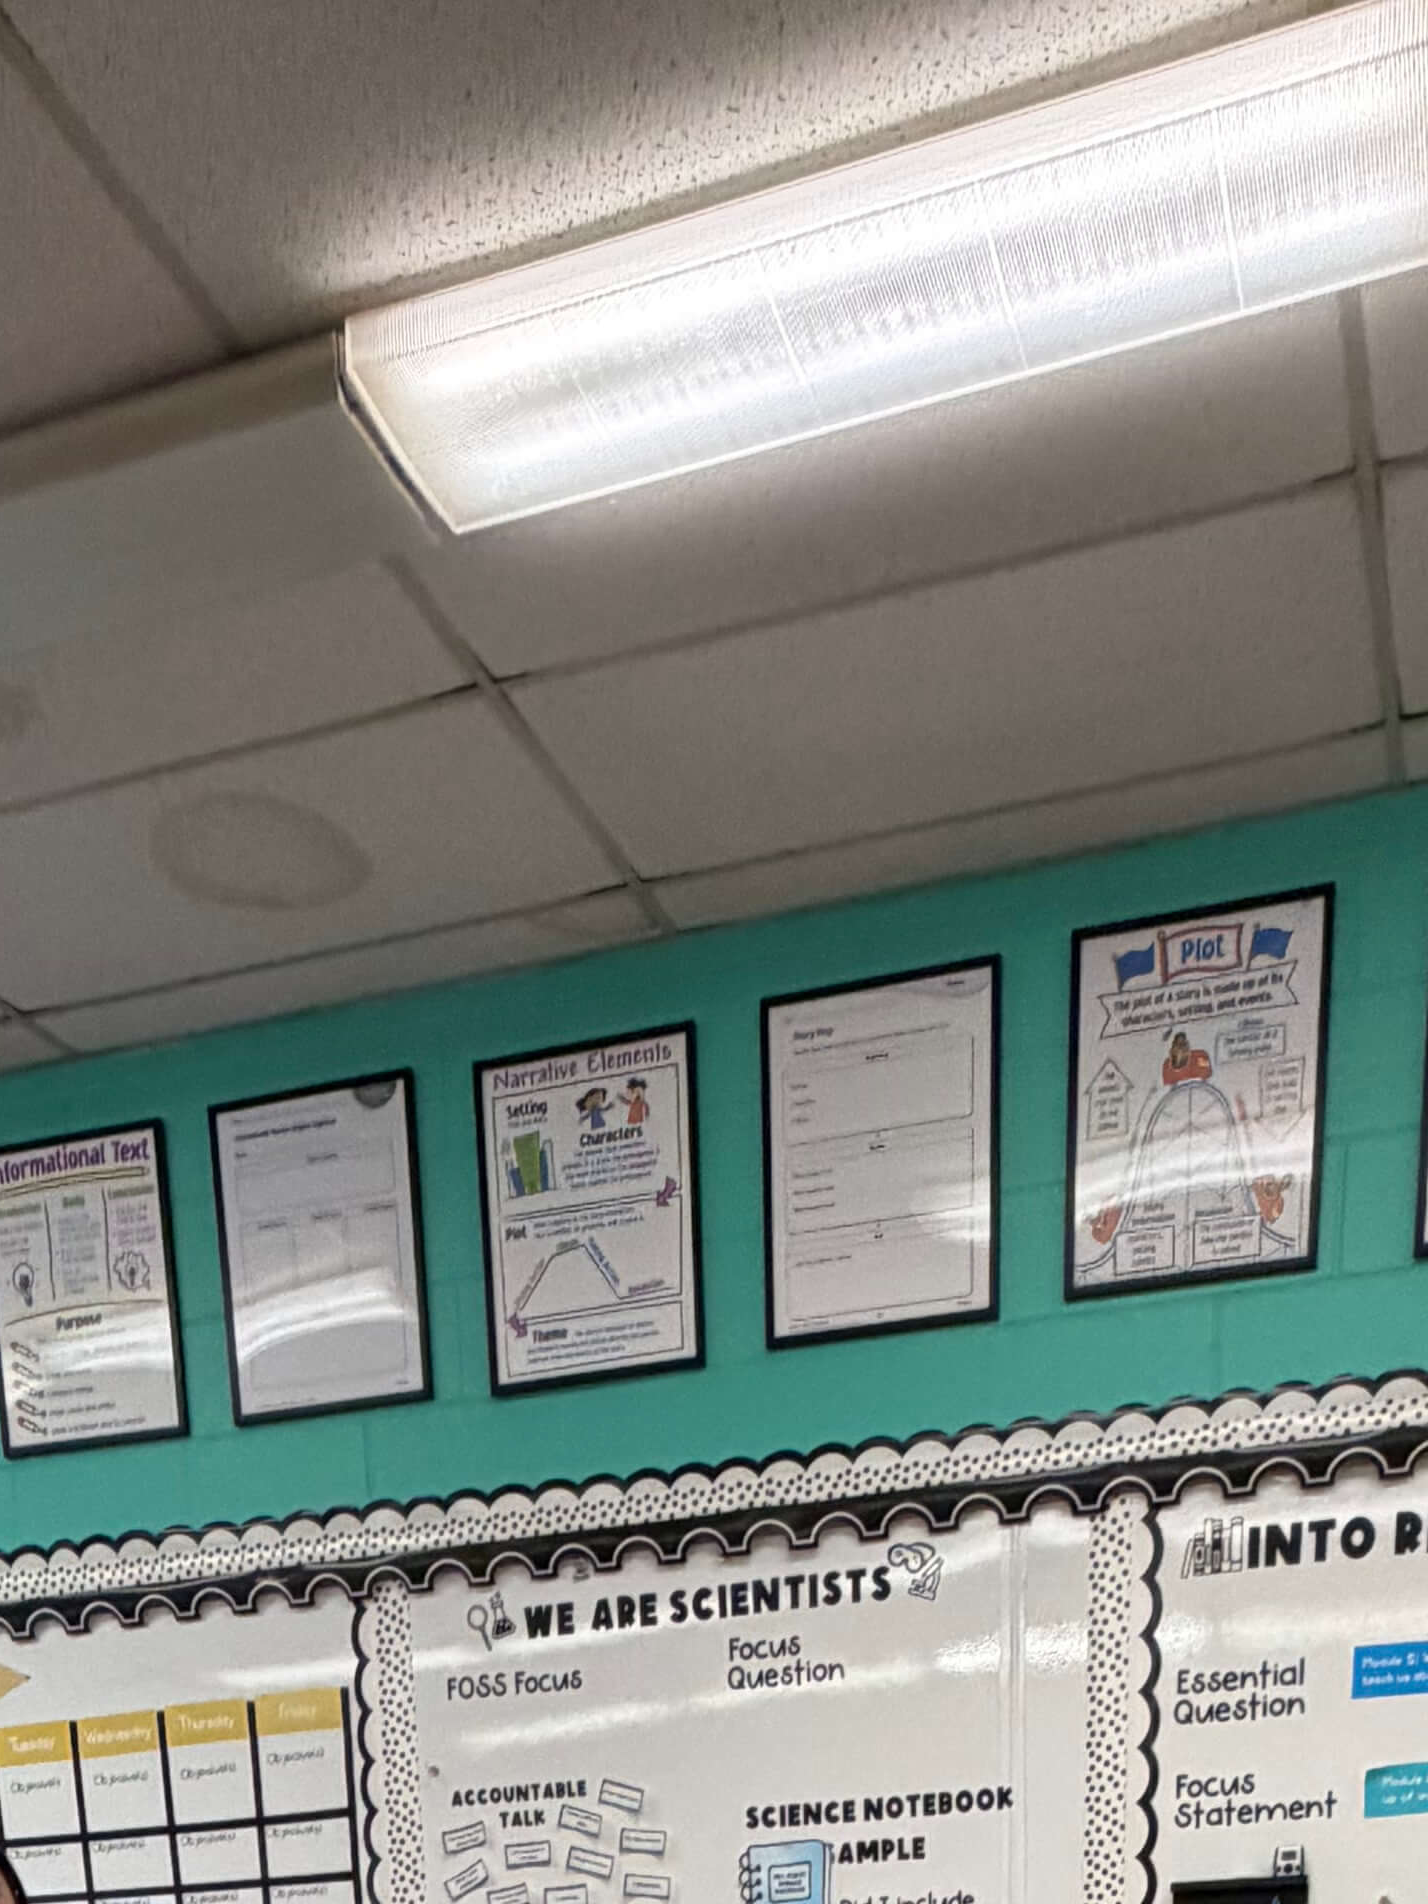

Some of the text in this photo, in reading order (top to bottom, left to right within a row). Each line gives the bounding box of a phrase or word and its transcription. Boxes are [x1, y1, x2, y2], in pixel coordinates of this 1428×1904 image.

[1180, 936, 1225, 965] Plot
[1132, 995, 1153, 1010] plot
[1154, 992, 1165, 1005] of
[1176, 988, 1201, 1003] story
[1202, 986, 1211, 997] is
[1213, 980, 1240, 994] made
[1243, 978, 1256, 990] up
[1257, 975, 1270, 988] of
[1216, 997, 1236, 1010] and
[493, 1042, 673, 1091] Narrative Elements
[505, 1099, 549, 1120] Setting
[579, 1125, 644, 1147] Characters
[110, 1137, 151, 1162] Text
[505, 1226, 527, 1241] Plot
[56, 1311, 103, 1332] Purpose
[532, 1327, 569, 1343] Theme
[1247, 1515, 1375, 1568] INTO
[524, 1566, 891, 1639] WE ARE SCIENTISTS
[728, 1635, 802, 1662] Focus
[1361, 1655, 1402, 1670] Module
[446, 1668, 584, 1701] FOSS Focus
[727, 1660, 846, 1691] Question
[1176, 1657, 1306, 1696] Essential
[1361, 1672, 1394, 1687] teach
[1397, 1673, 1411, 1685] us
[177, 1713, 235, 1733] Thursday
[278, 1703, 317, 1720] Friday
[1173, 1694, 1306, 1727] Question
[7, 1735, 57, 1754] Tuesday
[85, 1725, 152, 1746] Wednesday
[452, 1779, 587, 1807] ACCOUNTABLE
[1175, 1769, 1255, 1800] Focus
[1381, 1773, 1423, 1789] Module
[745, 1786, 1015, 1831] SCIENCE NOTEBOOK
[1400, 1790, 1414, 1804] of
[498, 1810, 545, 1829] TALK
[1173, 1792, 1338, 1829] Statement
[828, 1836, 926, 1865] AMPLE
